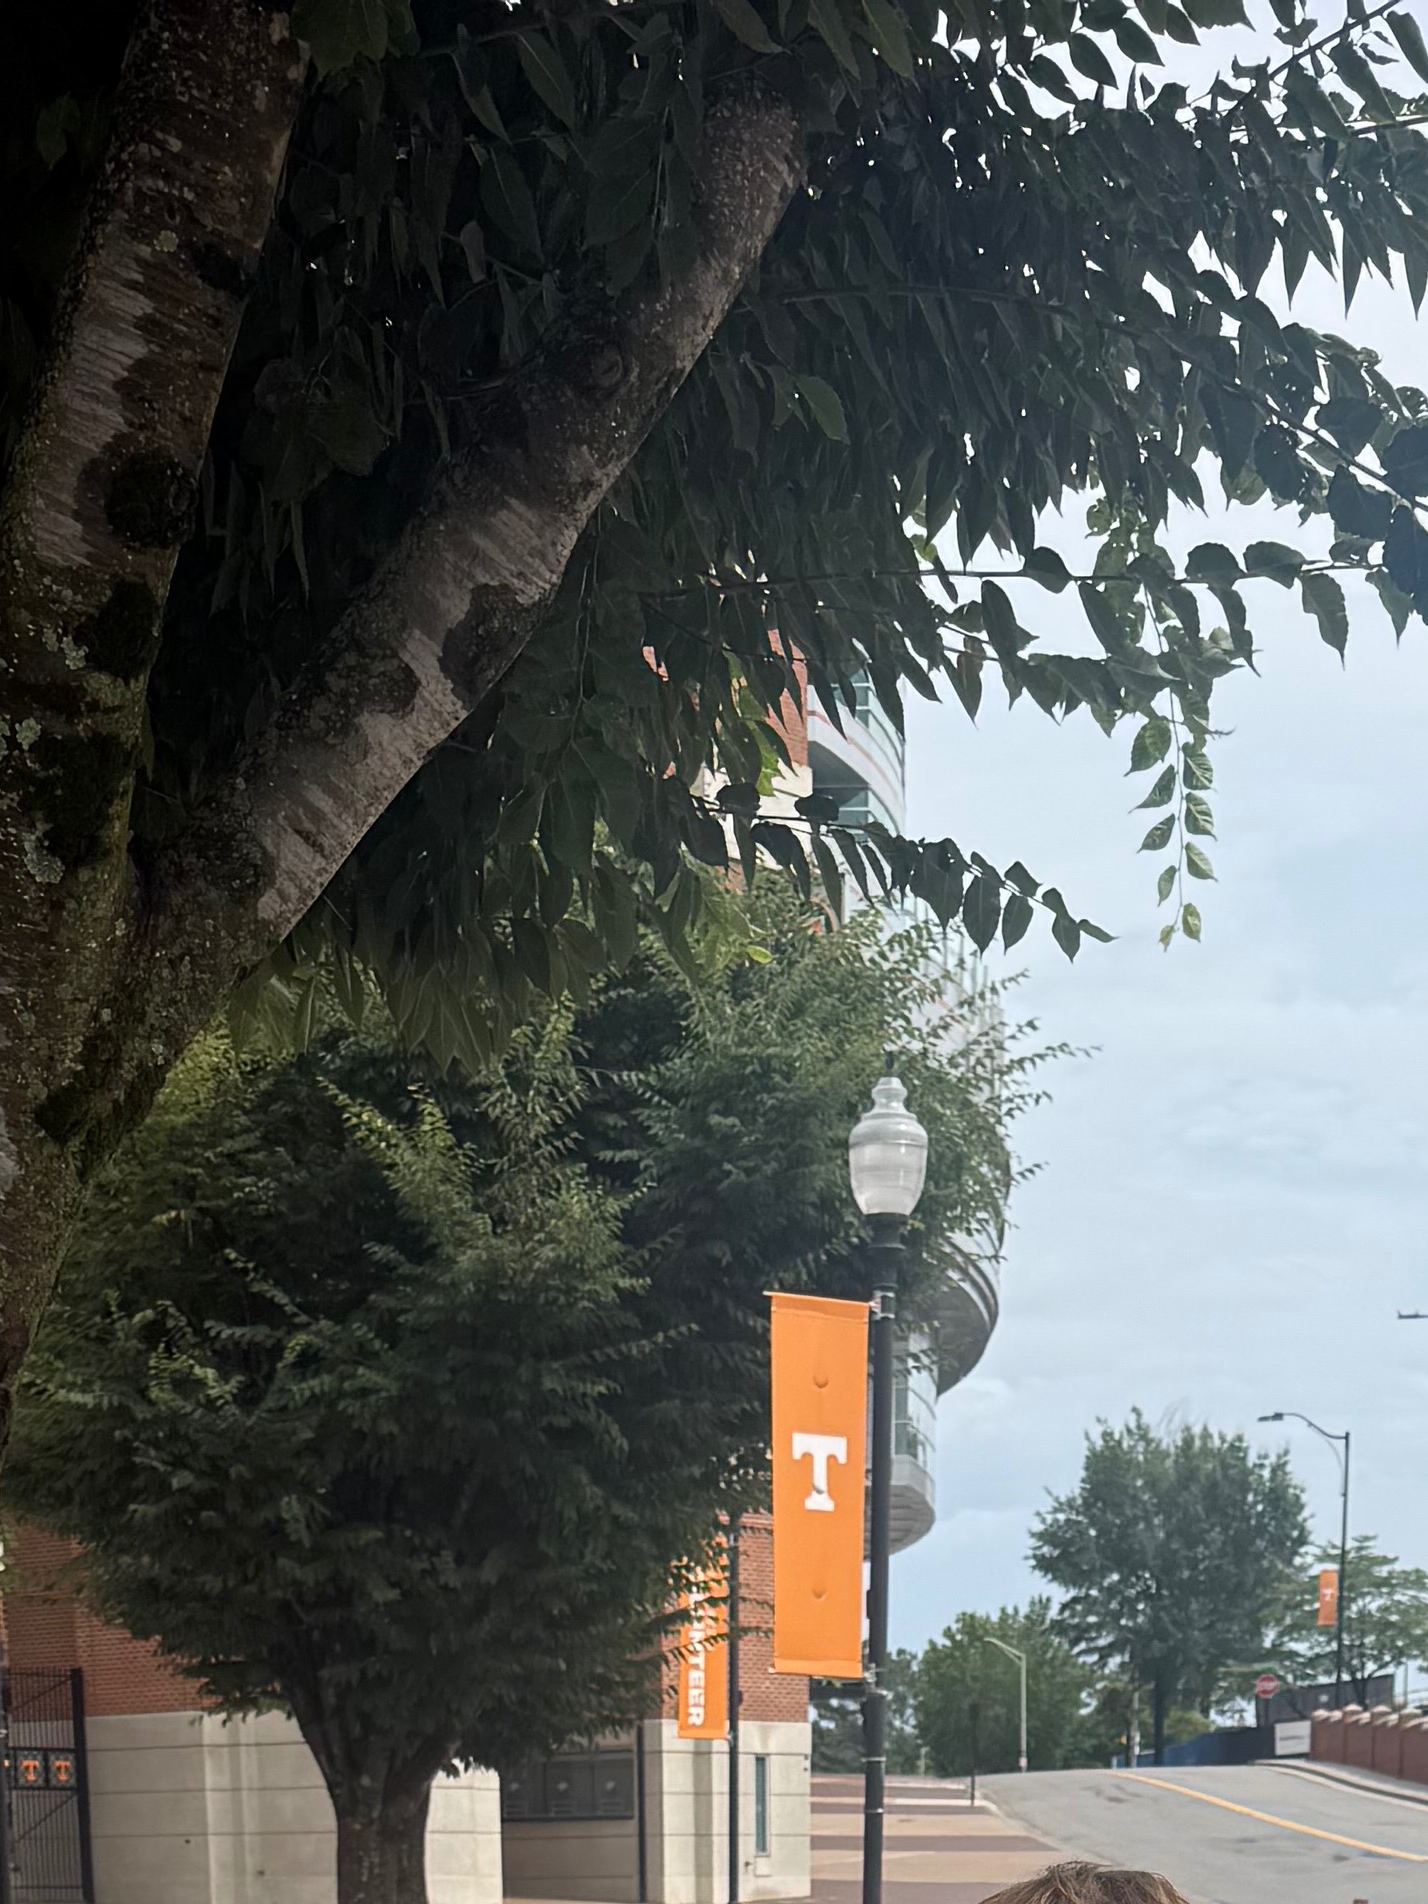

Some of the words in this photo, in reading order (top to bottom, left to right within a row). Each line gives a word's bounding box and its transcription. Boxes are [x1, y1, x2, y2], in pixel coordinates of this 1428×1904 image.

[792, 1432, 848, 1512] T
[21, 1759, 40, 1782] T
[53, 1759, 71, 1782] T
